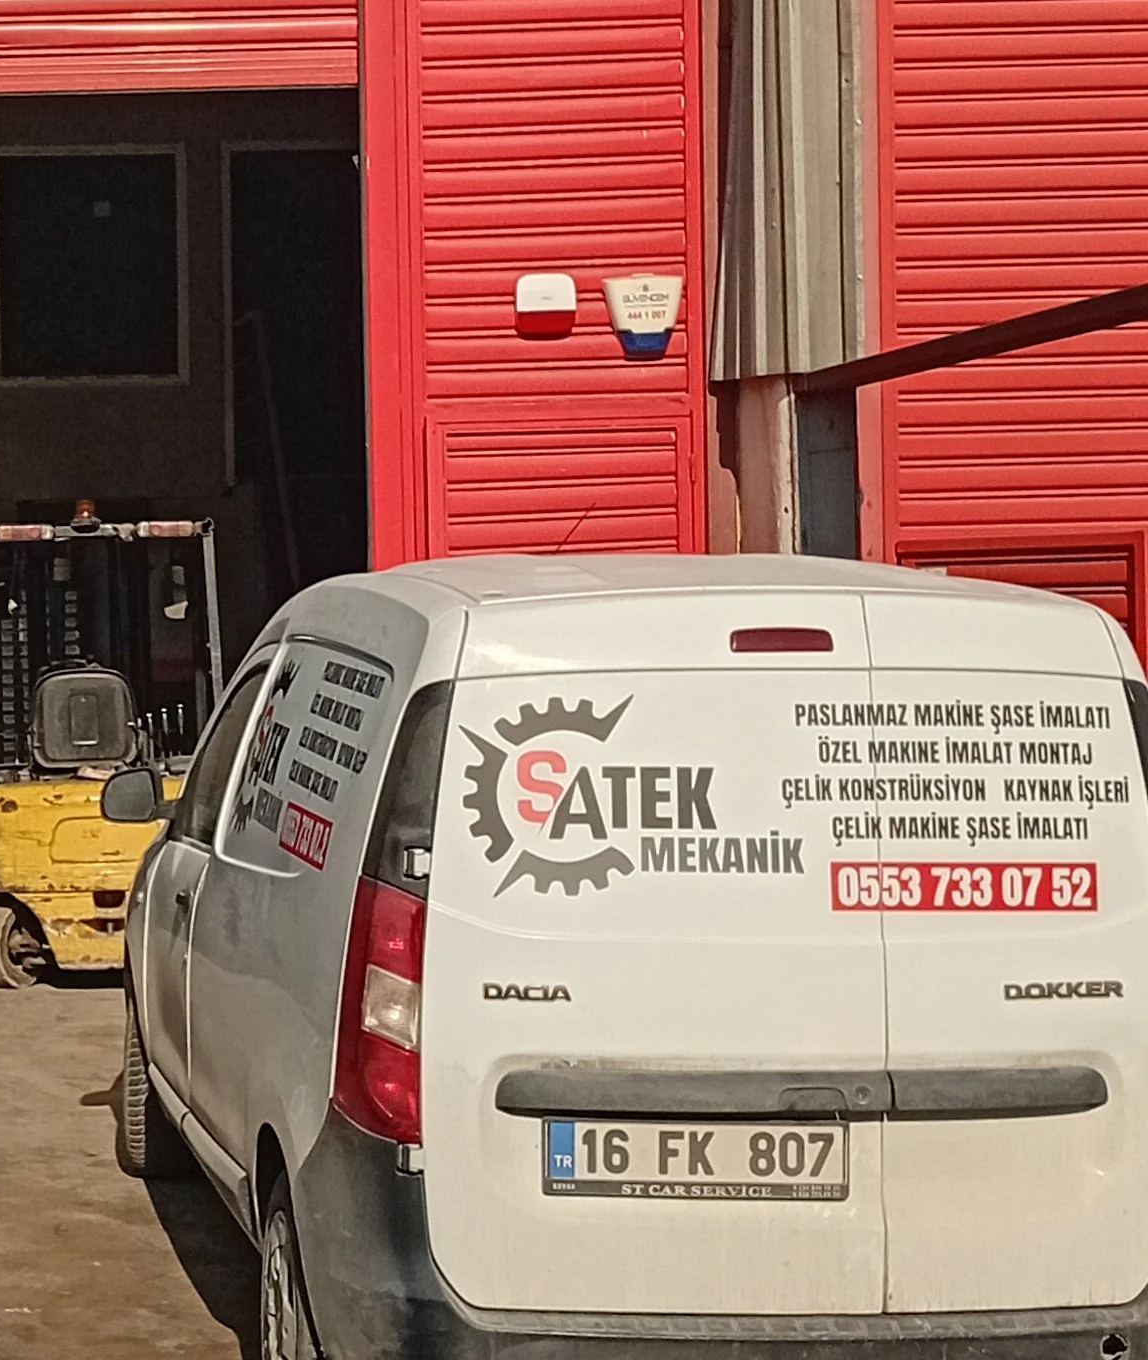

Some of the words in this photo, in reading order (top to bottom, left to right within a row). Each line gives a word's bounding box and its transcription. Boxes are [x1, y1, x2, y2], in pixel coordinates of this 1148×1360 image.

[794, 703, 908, 727] PASLANMAZ
[914, 699, 984, 727] MAKİNE
[990, 704, 1035, 735] ŞASE
[1040, 700, 1111, 729] İMALATI
[818, 735, 862, 764] ÖZEL
[945, 736, 1013, 764] İMALAT
[1019, 742, 1093, 765] MONTAJ
[517, 750, 717, 840] SATEK
[782, 773, 833, 809] ÇELİK
[838, 773, 986, 802] KONSTRÜKSİYON
[1004, 778, 1074, 802] KAYNAK
[1078, 774, 1130, 810] İŞLERİ
[832, 811, 882, 847] ÇELİK
[889, 811, 960, 840] MAKİNE
[966, 816, 1011, 847] ŞASE
[1017, 812, 1089, 840] İMALATI
[640, 830, 804, 874] MEKANİK
[837, 866, 922, 907] 0553
[930, 867, 993, 907] 733
[1001, 867, 1043, 907] 07
[1051, 867, 1092, 907] 52
[482, 982, 572, 1002] DACIA
[1003, 980, 1124, 1000] DOKKER
[554, 1154, 572, 1169] TR
[582, 1128, 630, 1174] 16
[658, 1130, 715, 1175] FK
[748, 1131, 835, 1177] 807
[621, 1184, 644, 1196] ST
[648, 1184, 686, 1196] CAR
